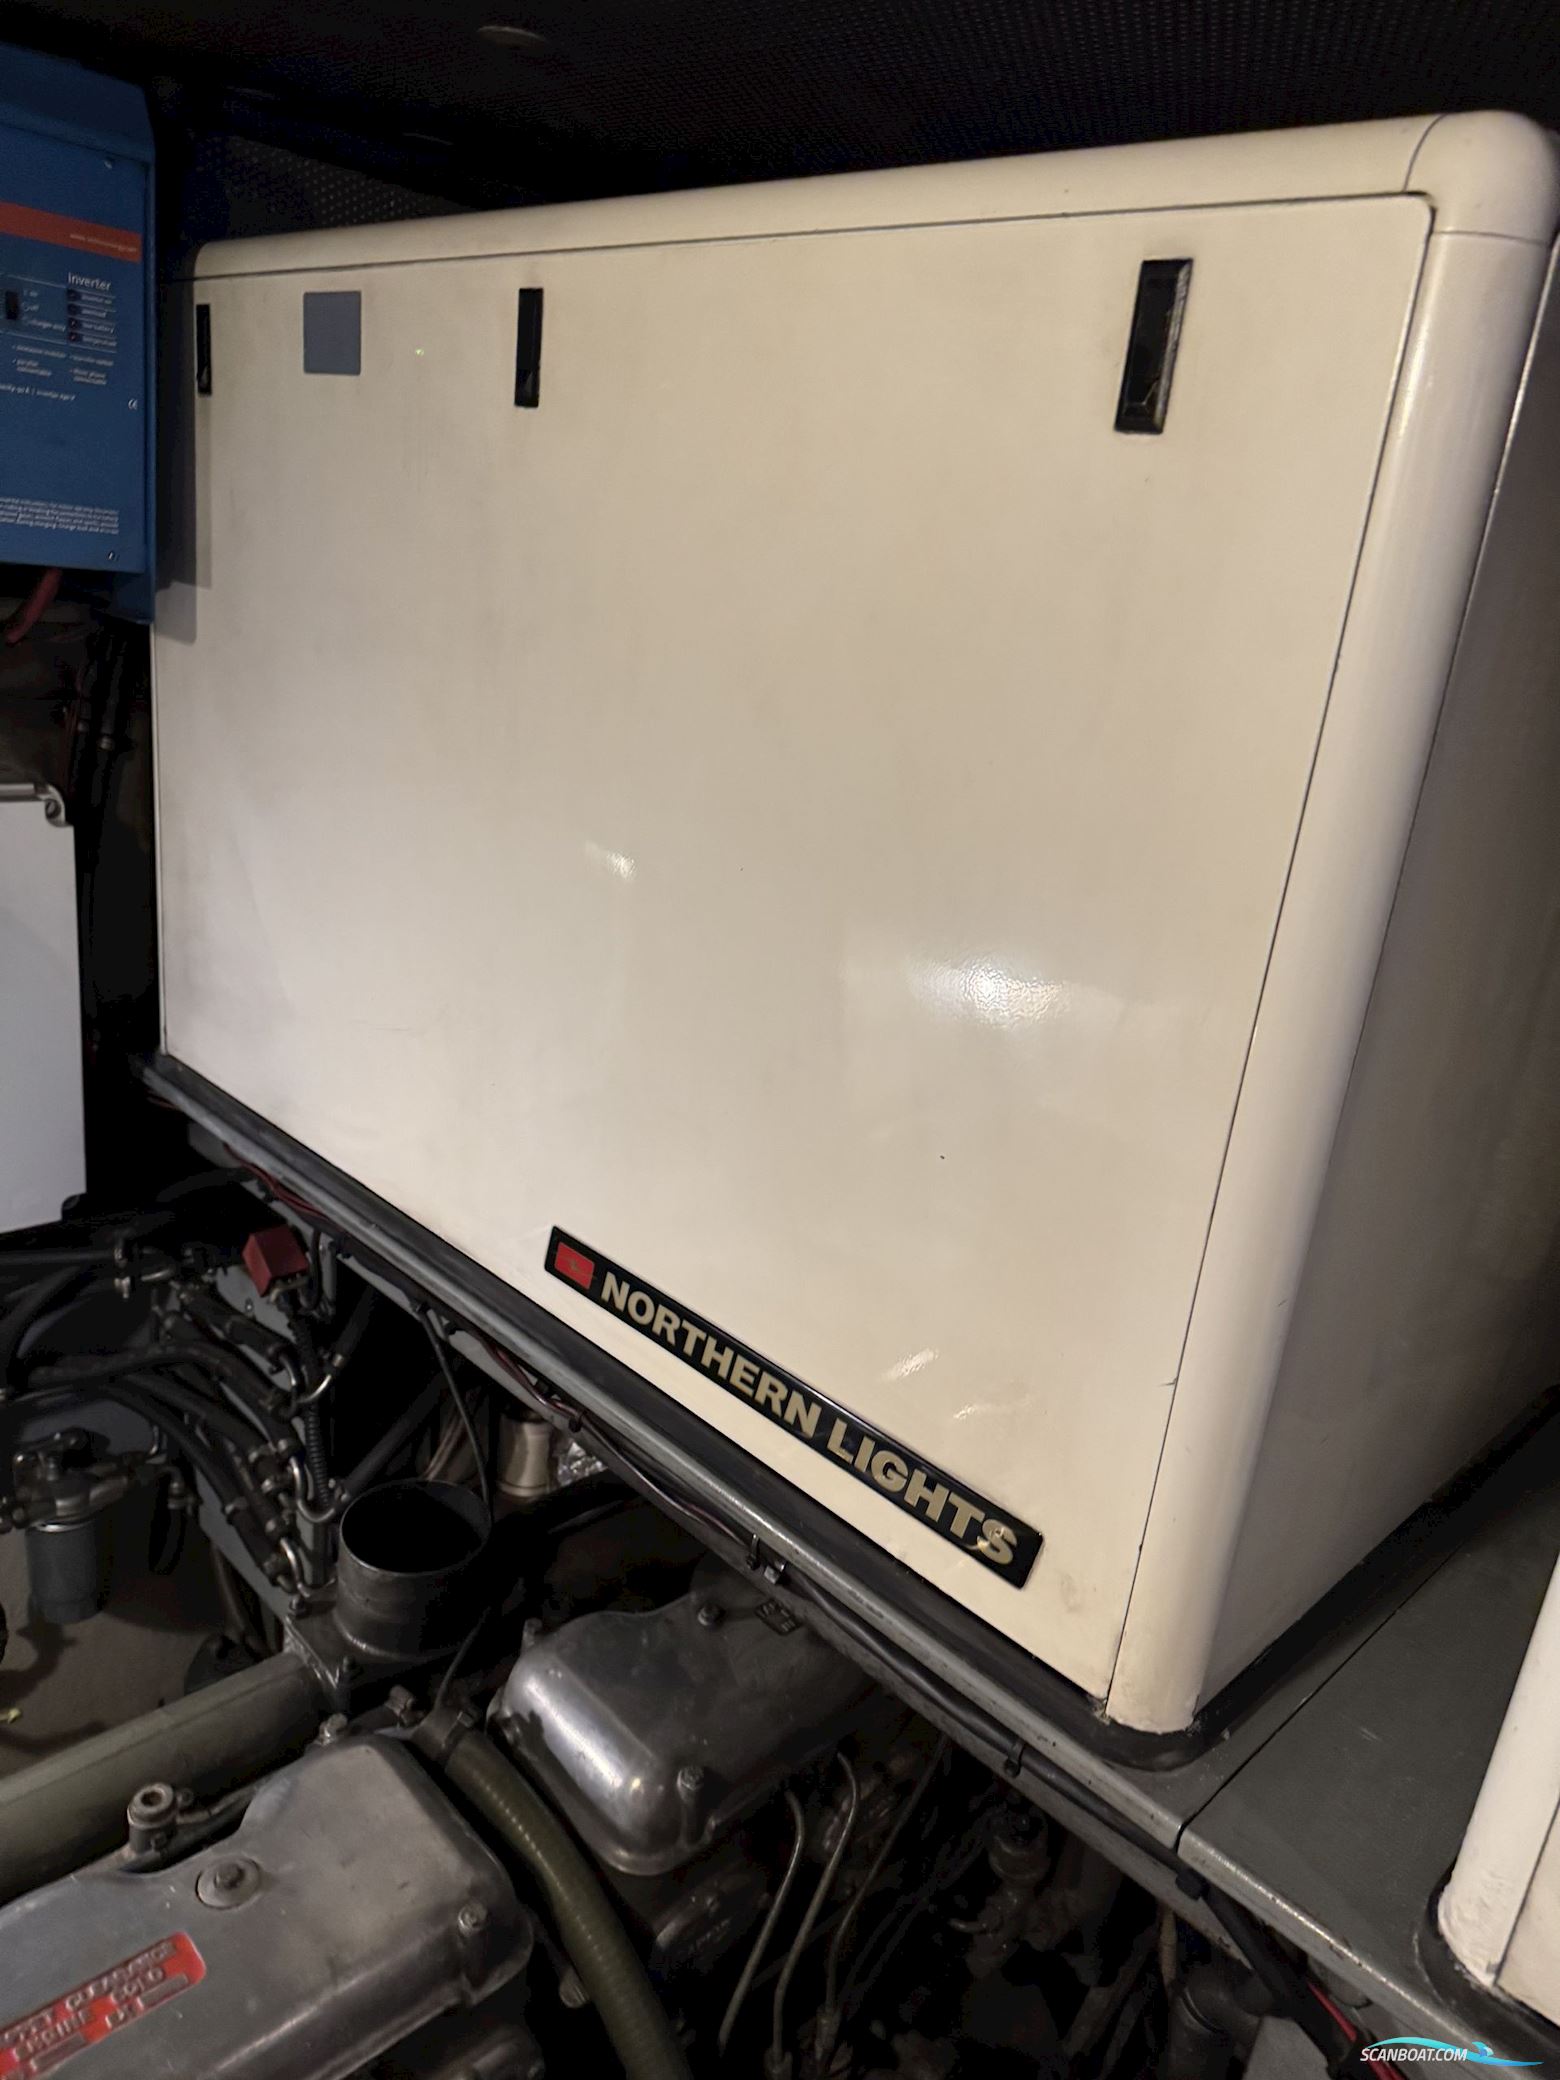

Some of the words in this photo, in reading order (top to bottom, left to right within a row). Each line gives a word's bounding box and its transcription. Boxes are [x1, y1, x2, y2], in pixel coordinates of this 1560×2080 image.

[68, 271, 112, 291] Inverter
[601, 1271, 822, 1439] NORTHERN
[827, 1418, 1018, 1565] LIGHTS
